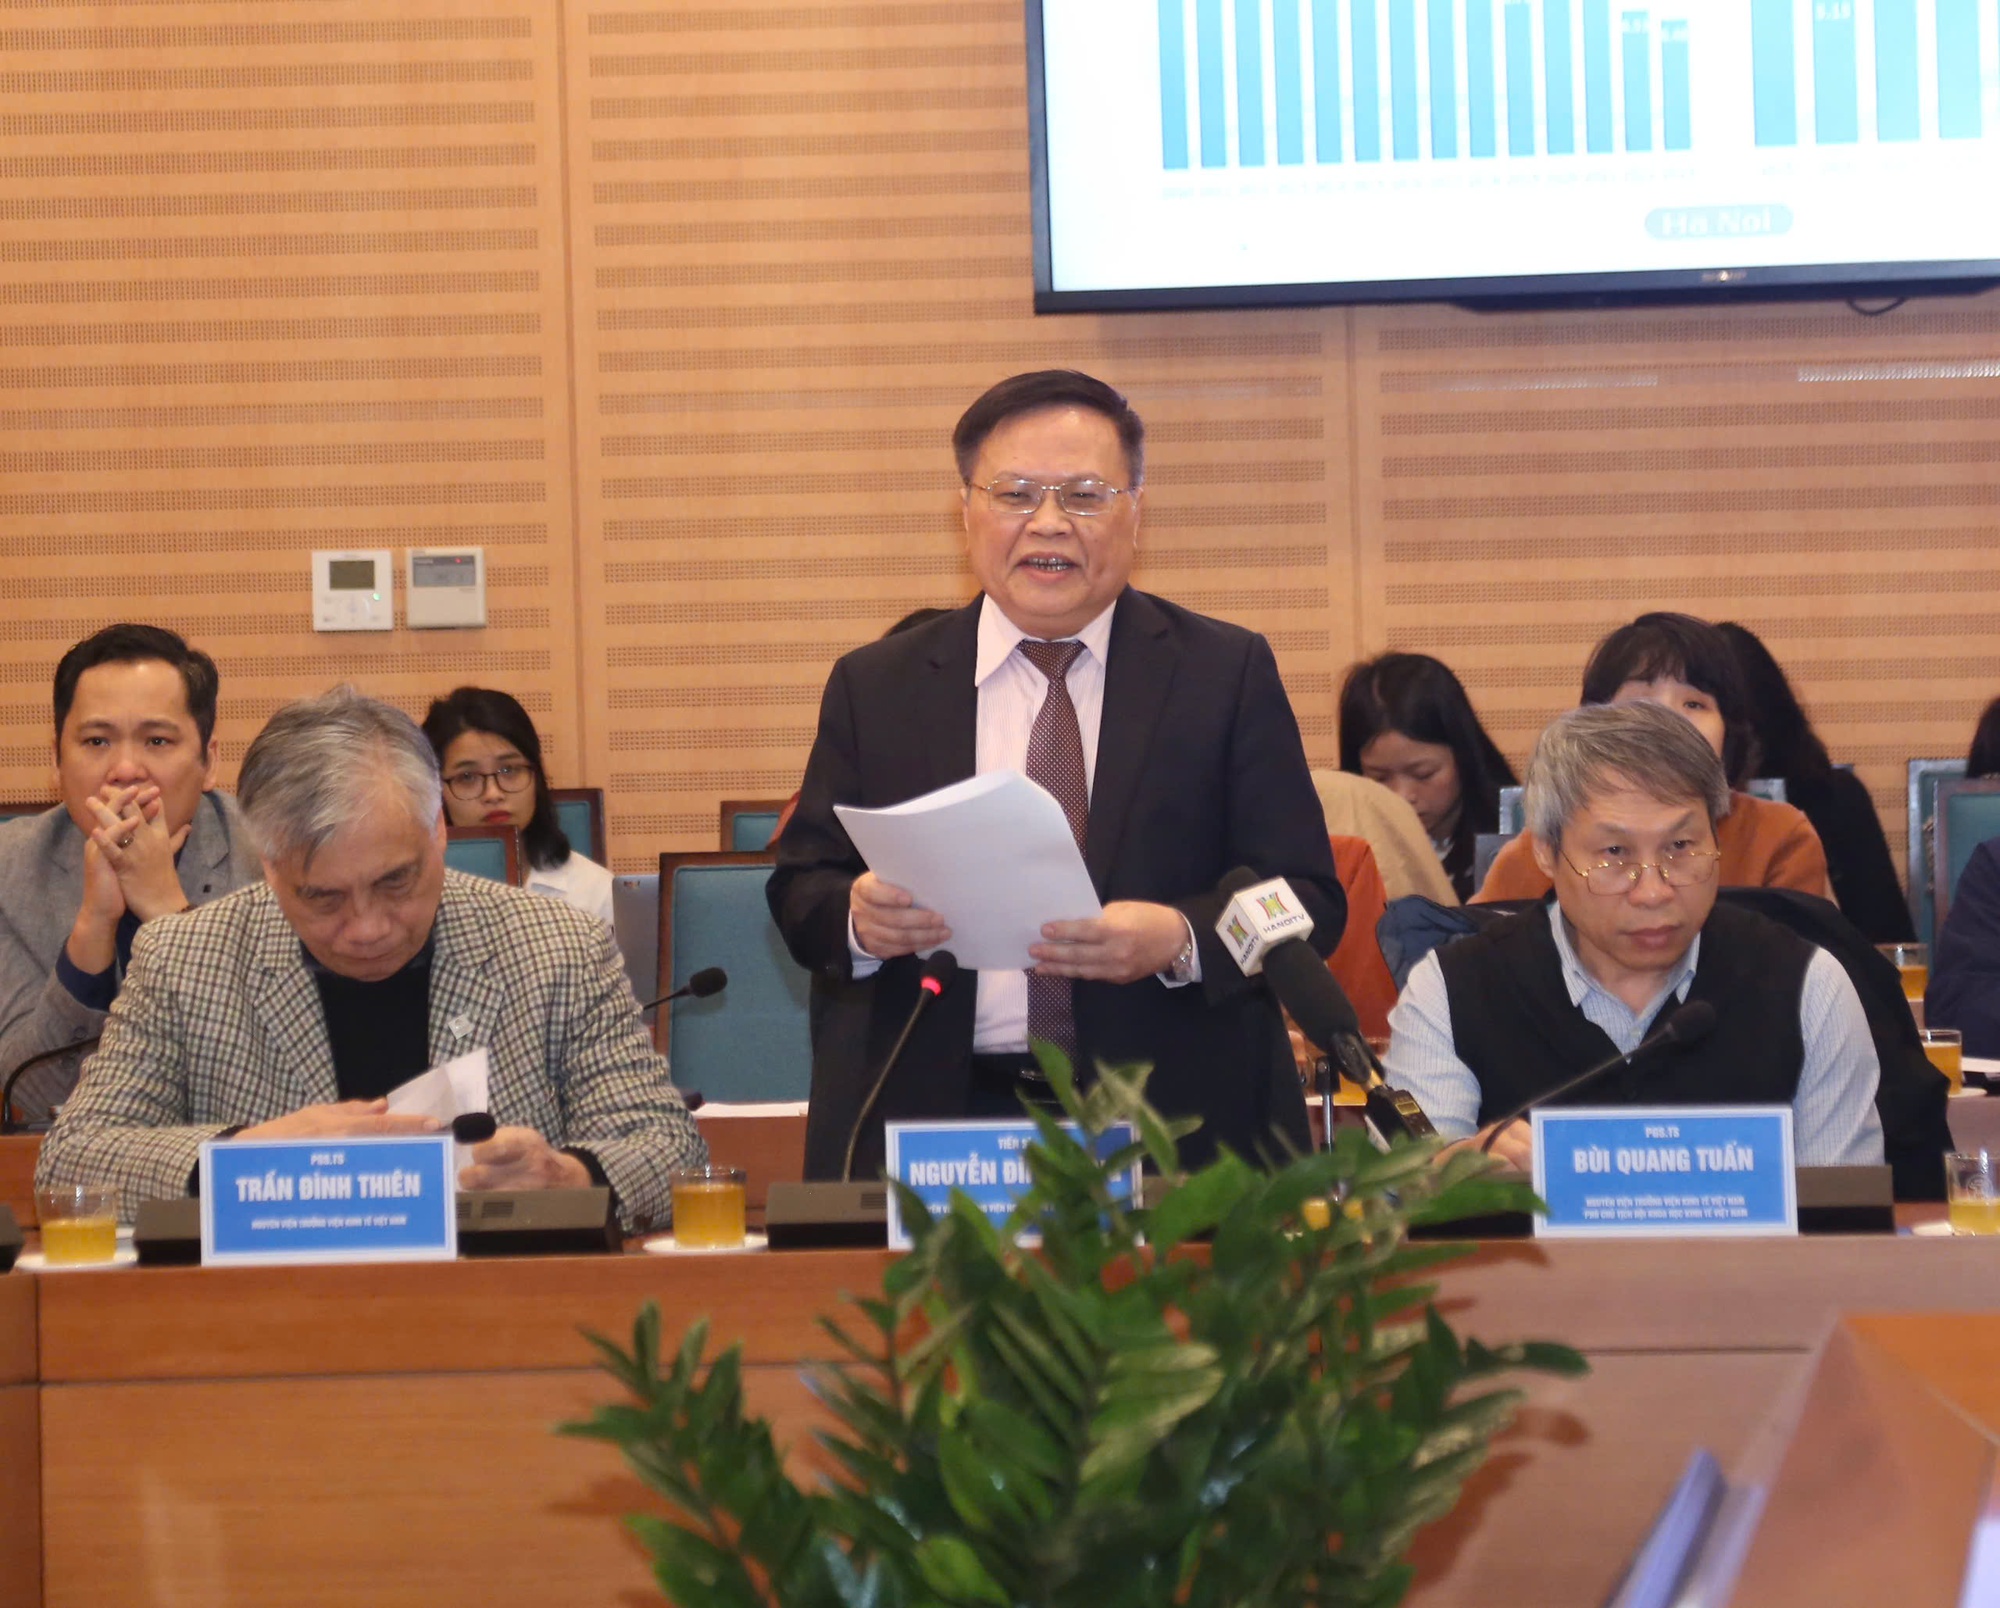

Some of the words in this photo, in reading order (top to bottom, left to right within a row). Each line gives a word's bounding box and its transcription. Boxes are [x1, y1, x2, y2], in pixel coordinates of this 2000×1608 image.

[1262, 914, 1305, 933] HANOITV
[910, 1152, 997, 1186] NGUYỄN
[1574, 1145, 1610, 1173] BÙI
[1616, 1148, 1691, 1175] QUANG
[299, 1172, 351, 1200] ĐÌNH
[357, 1168, 421, 1199] THIÊN
